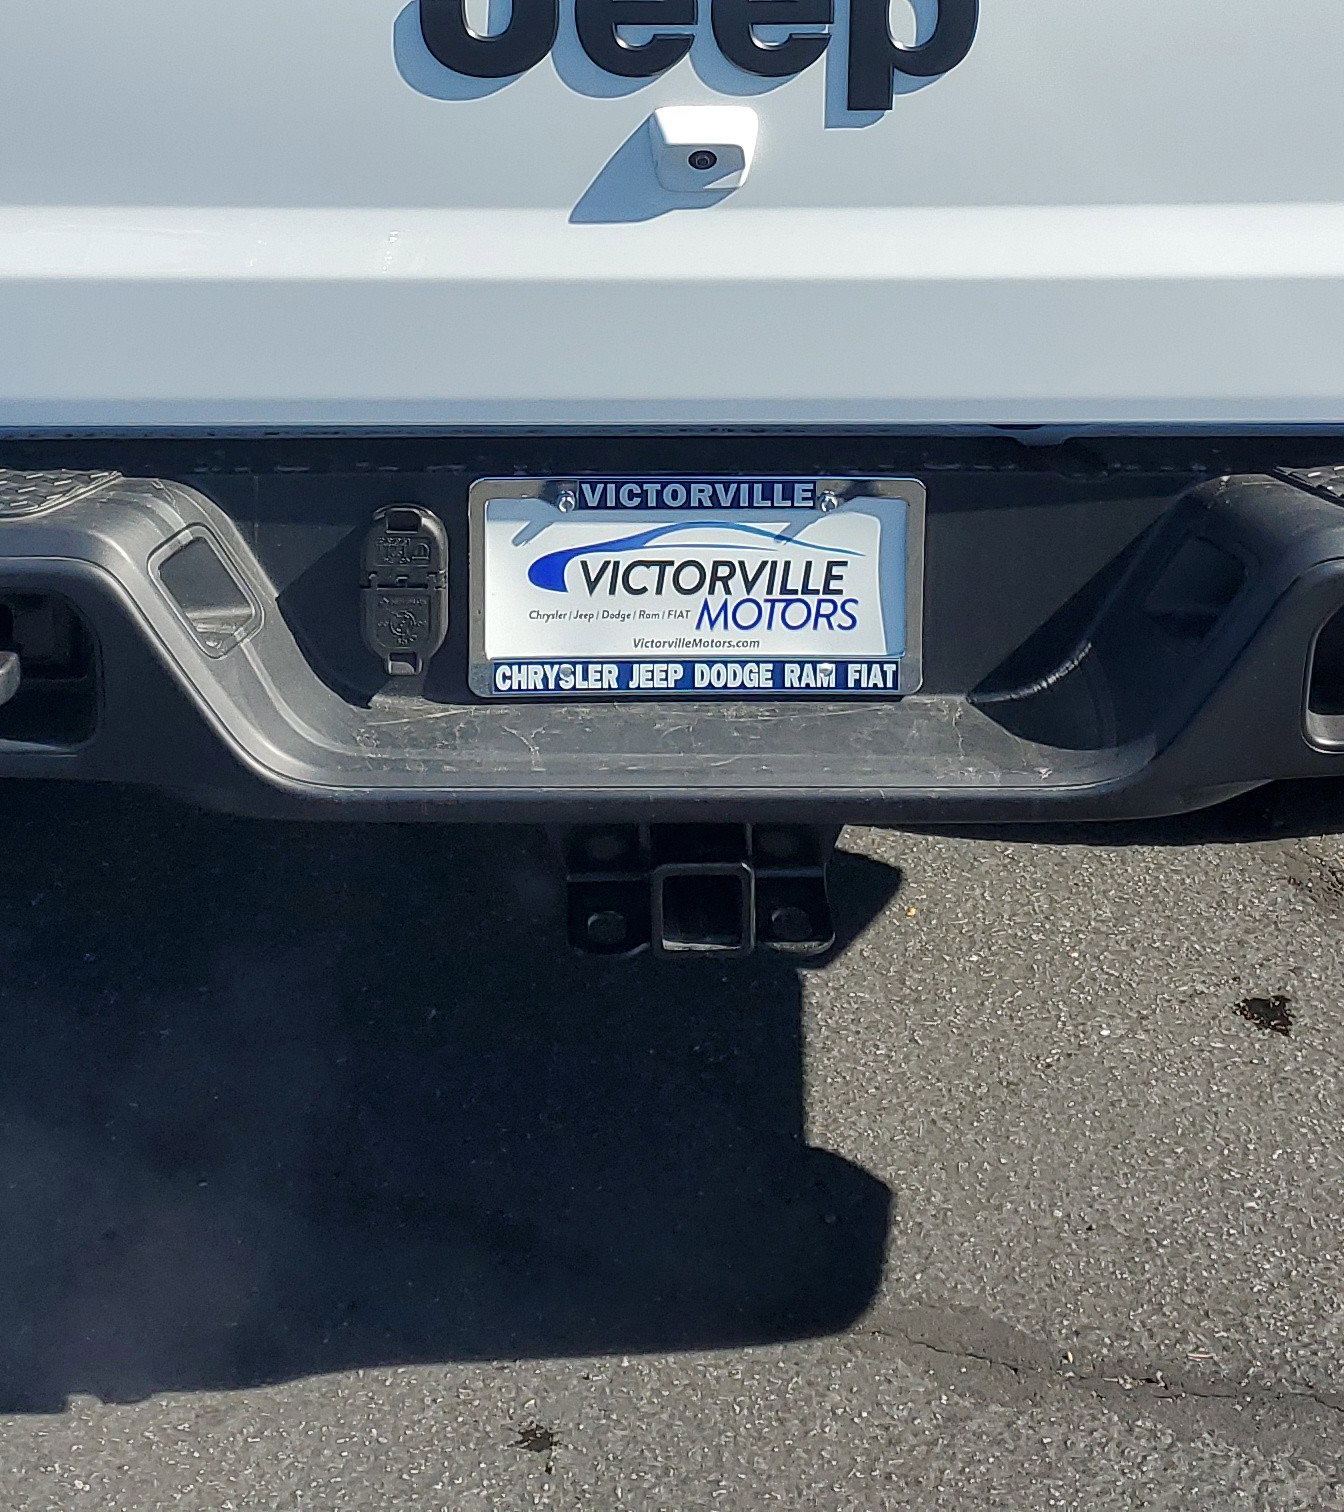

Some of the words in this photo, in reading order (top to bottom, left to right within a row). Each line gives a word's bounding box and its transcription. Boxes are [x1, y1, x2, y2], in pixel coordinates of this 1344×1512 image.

[581, 483, 814, 507] VICTORVILLE
[580, 560, 849, 596] VICTORVILLE
[528, 610, 568, 623] Chrysler
[573, 610, 595, 622] Jeep
[602, 610, 631, 622] Dodge
[638, 610, 660, 620] Ram
[667, 610, 691, 620] FIAT
[695, 598, 860, 631] MOTORS
[633, 638, 760, 649] VictorvilleMotors.com
[495, 664, 619, 690] CHRYSLER
[629, 664, 684, 689] JEEP
[694, 663, 774, 688] DODGE
[784, 663, 836, 688] RAM
[847, 663, 897, 688] FIAT
